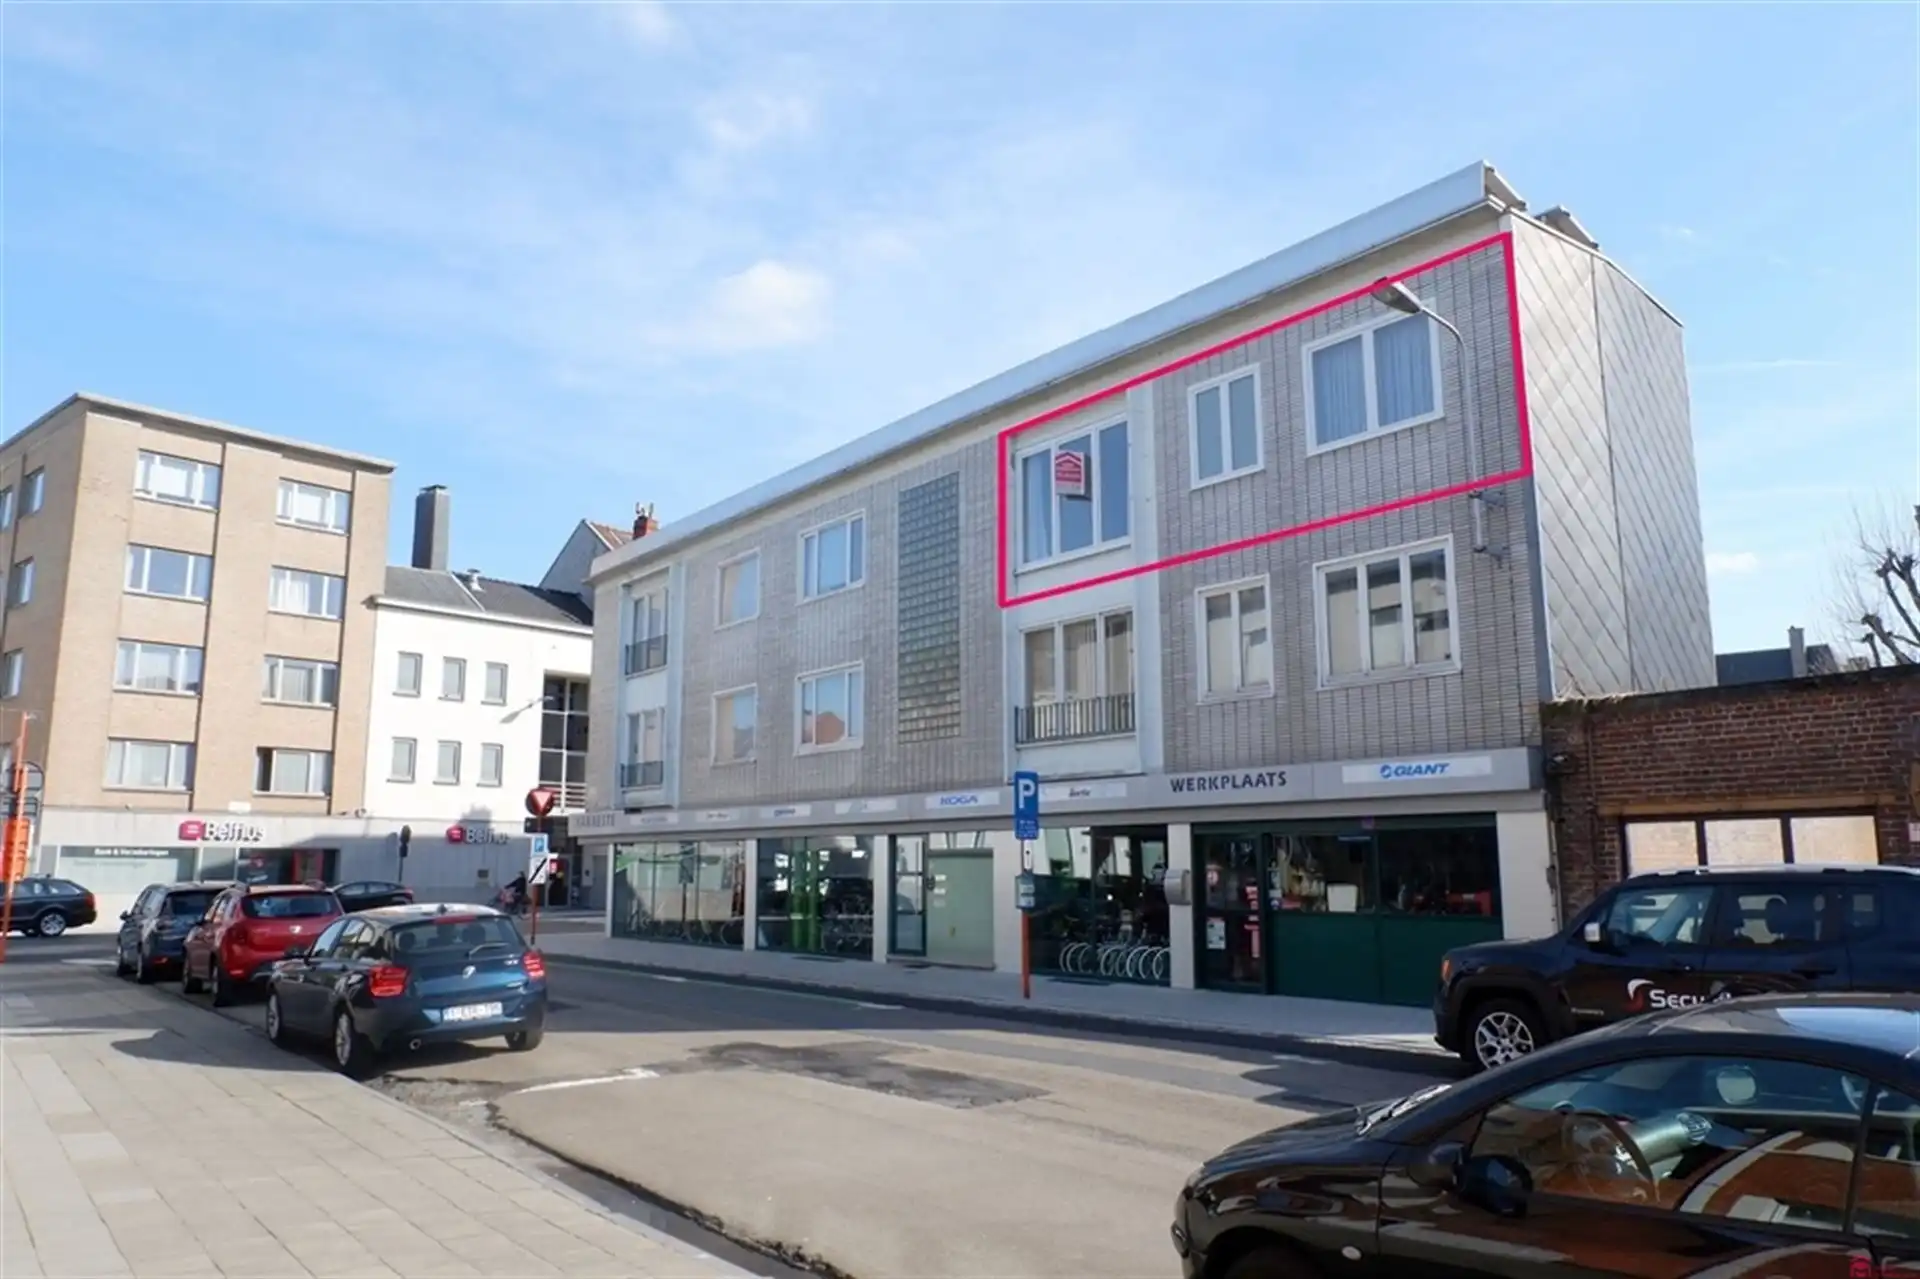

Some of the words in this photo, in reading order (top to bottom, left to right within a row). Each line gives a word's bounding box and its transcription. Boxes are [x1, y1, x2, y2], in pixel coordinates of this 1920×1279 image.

[1394, 763, 1449, 777] GIANT
[1170, 770, 1287, 793] WERKPLAATS
[940, 794, 978, 806] KOGA
[1018, 778, 1035, 809] P
[205, 821, 265, 842] Belfius
